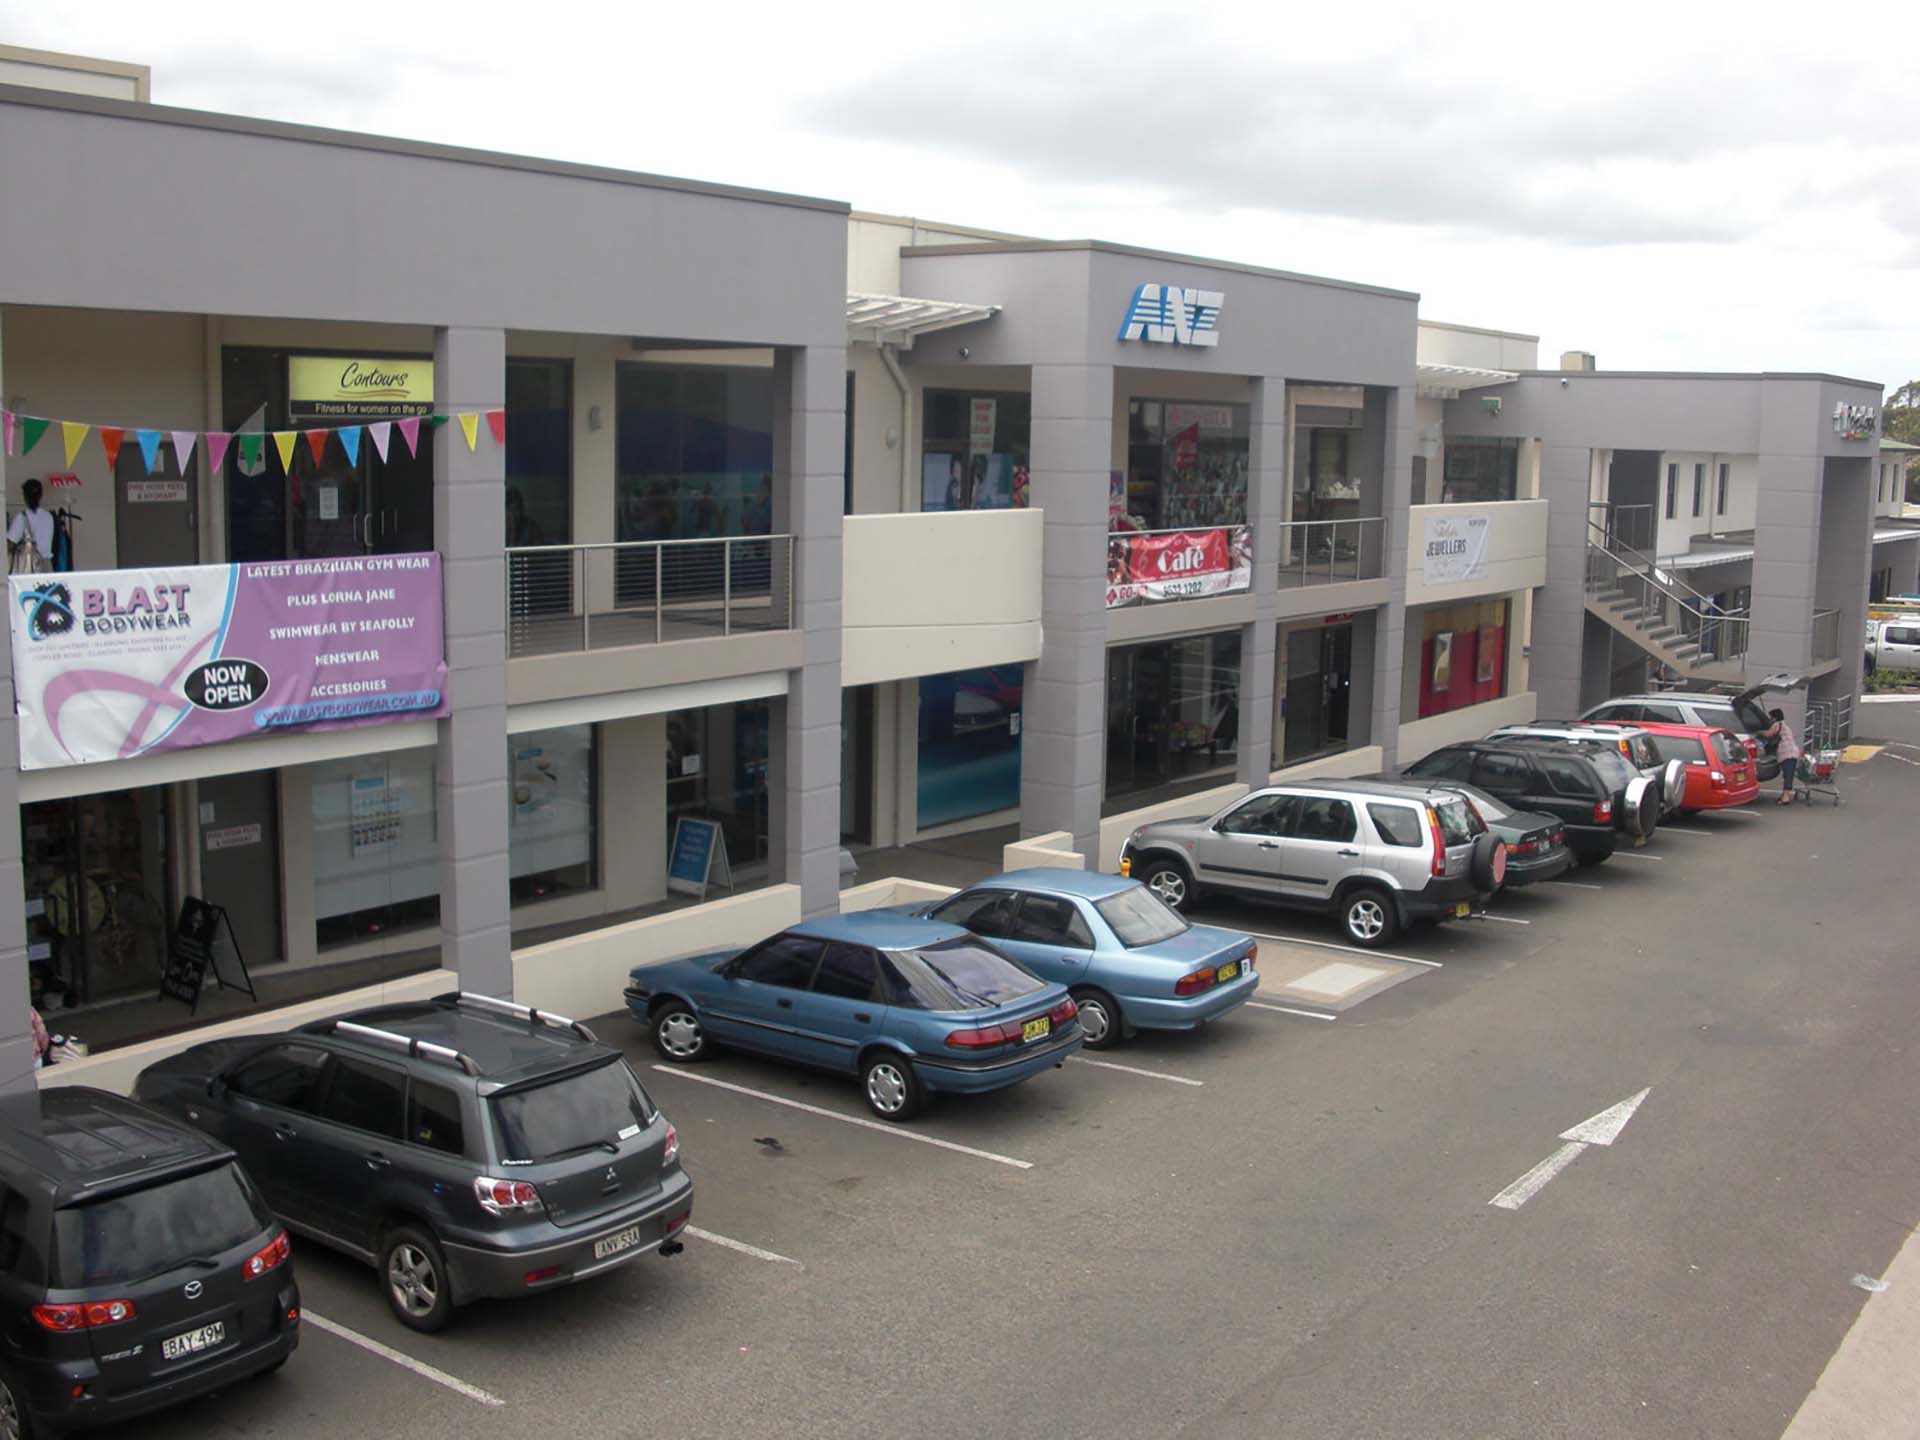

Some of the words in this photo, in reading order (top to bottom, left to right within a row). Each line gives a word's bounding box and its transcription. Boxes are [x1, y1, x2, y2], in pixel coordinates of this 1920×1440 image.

[1119, 283, 1224, 346] ANZ
[340, 361, 408, 388] Contours
[315, 403, 345, 414] Fitness
[347, 403, 359, 414] for
[360, 405, 389, 414] women
[390, 405, 401, 414] on
[402, 404, 415, 414] the
[416, 405, 427, 415] go
[247, 565, 291, 578] LATEST
[295, 560, 363, 576] BRAZILIAN
[366, 558, 393, 571] GYM
[395, 557, 430, 569] WEAR
[82, 584, 191, 618] BLAST
[287, 593, 318, 607] PLUS
[321, 590, 363, 605] LORNA
[366, 588, 396, 603] JANE
[83, 612, 192, 636] BODYWEAR
[269, 622, 337, 640] SWIMWEAR
[341, 621, 357, 634] BY
[360, 617, 416, 632] SEAFOLLY
[314, 650, 380, 666] MENSWEAR
[203, 665, 247, 686] NOW
[203, 684, 252, 705] OPEN
[310, 679, 387, 697] ACCESSORIES
